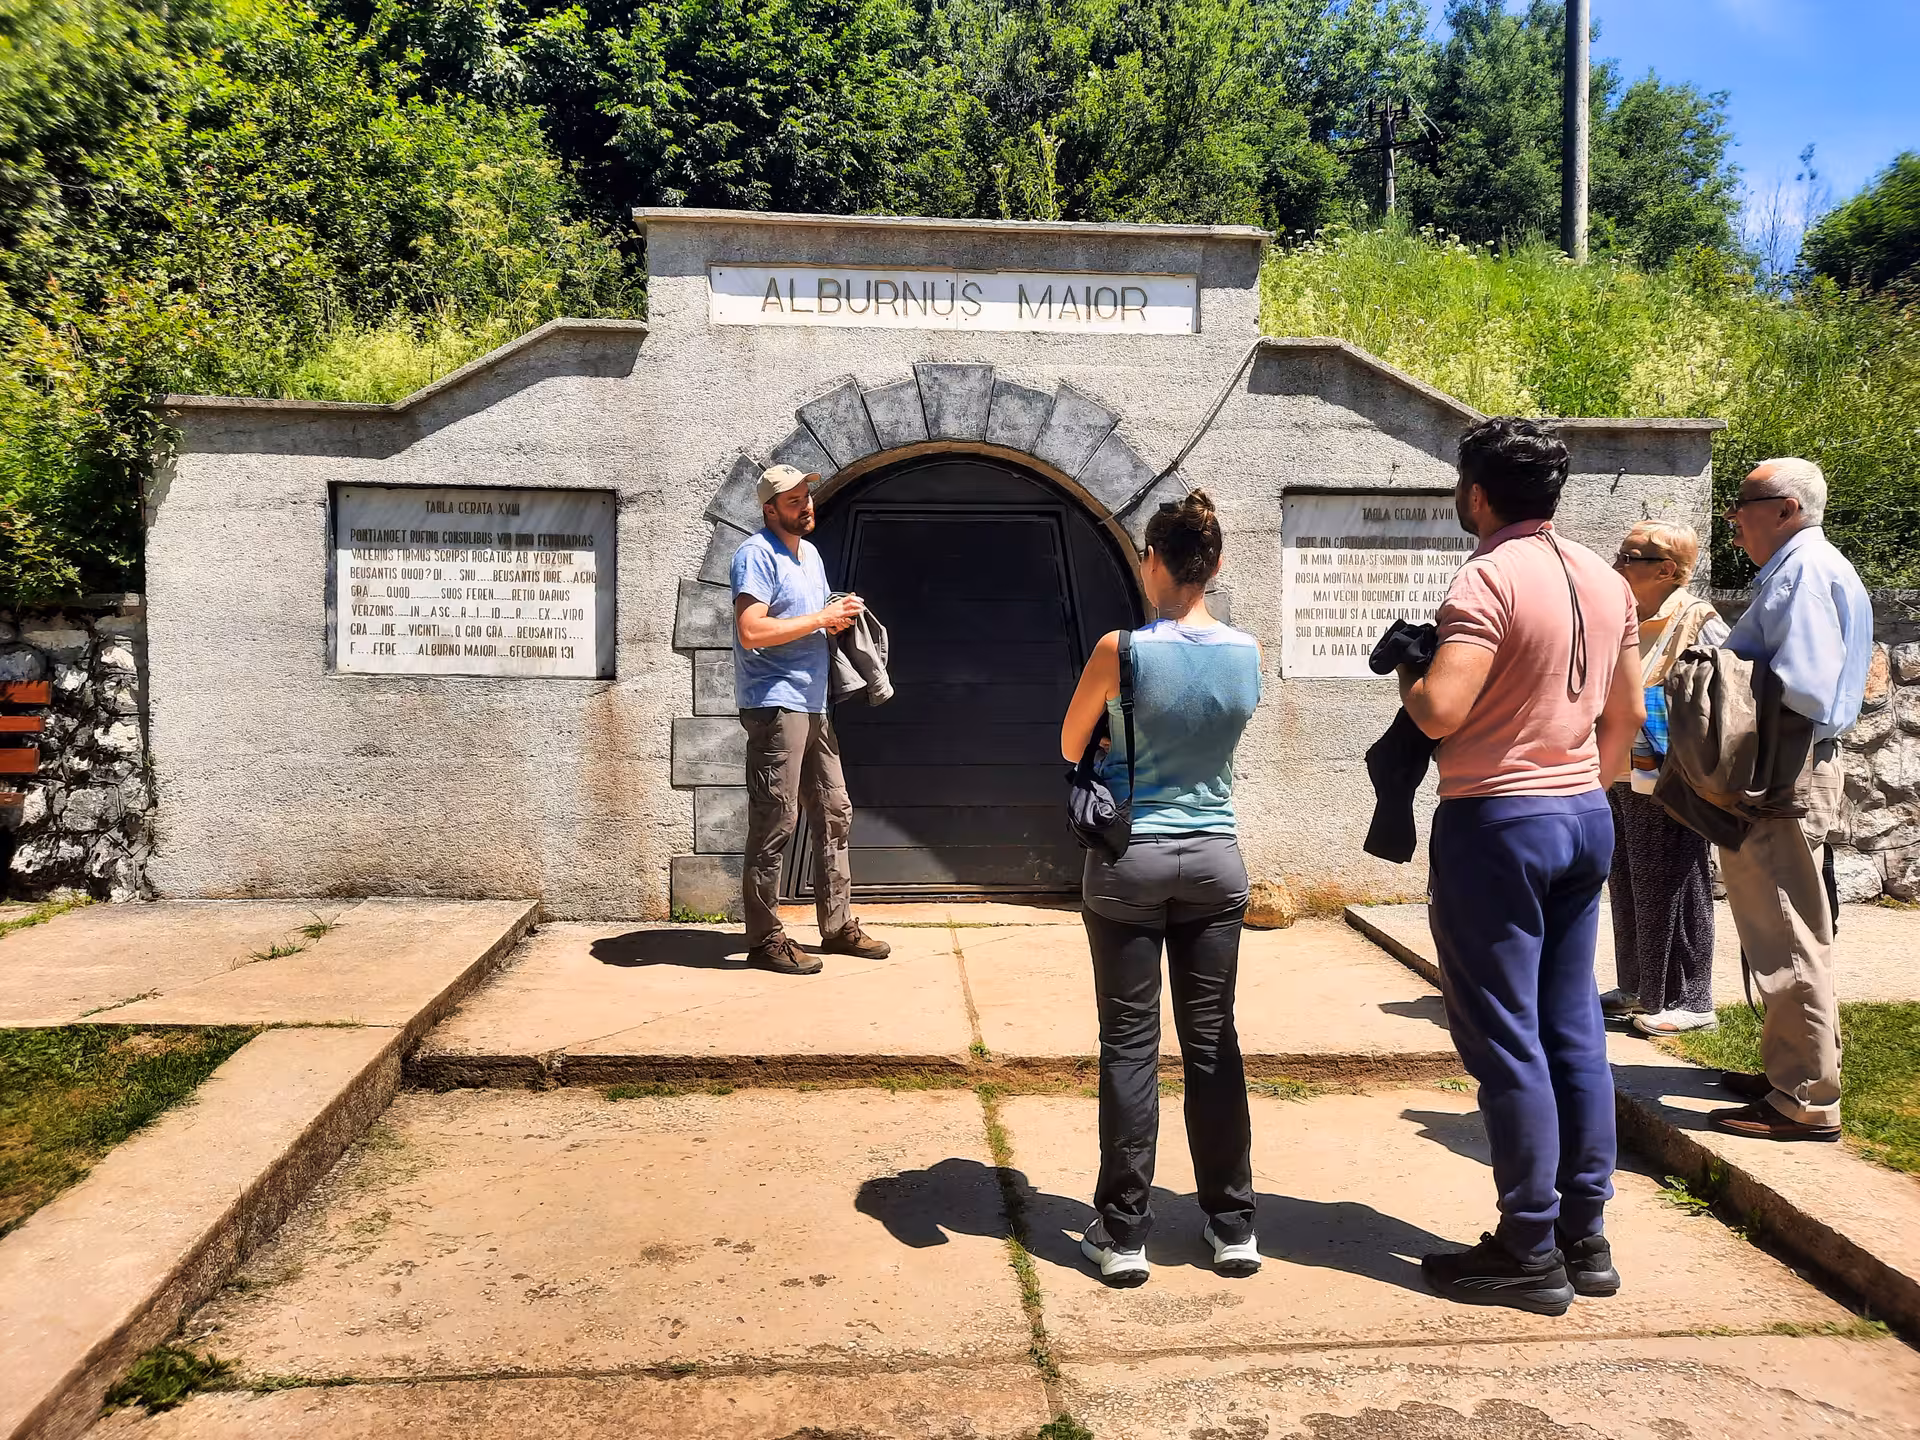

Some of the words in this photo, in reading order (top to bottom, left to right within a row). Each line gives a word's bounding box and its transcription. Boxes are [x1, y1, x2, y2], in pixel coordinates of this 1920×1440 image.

[761, 277, 983, 317] ALBURNUS
[1018, 284, 1149, 321] MAIOR
[425, 500, 454, 514] TABLA
[459, 502, 493, 515] CERATA
[1431, 508, 1453, 520] XVIII
[410, 530, 438, 544] RUFINO
[442, 531, 493, 545] CONSULIBUS
[1320, 536, 1332, 549] UN
[351, 548, 394, 561] VALERIUS
[397, 549, 431, 562] FIRMUS
[434, 549, 469, 563] SCRIPSI
[471, 550, 513, 564] ROGATUS
[515, 551, 529, 564] AB
[1300, 554, 1308, 566] IN
[1311, 554, 1333, 566] MINA
[350, 566, 398, 580] BEUSANTIS
[1295, 572, 1320, 584] ROSIA
[1323, 572, 1364, 585] MONTANA
[1367, 572, 1410, 585] IMPREUNA
[1413, 572, 1424, 585] CU
[1427, 572, 1449, 585] ALTE
[539, 589, 570, 602] DARIUS
[1313, 590, 1331, 602] MAI
[1333, 590, 1359, 602] VECHI
[1408, 591, 1419, 603] CE
[1422, 590, 1447, 603] ATEST
[1295, 608, 1347, 620] MINERITULUI
[1350, 608, 1358, 620] SI
[1361, 608, 1368, 620] A
[1371, 608, 1420, 620] LOCALITATII
[1295, 626, 1312, 638] SUB
[1314, 626, 1363, 638] DENUMIREA
[1367, 626, 1378, 638] DE
[561, 646, 574, 659] 131
[1312, 644, 1327, 656] LA
[1331, 644, 1357, 656] DATA
